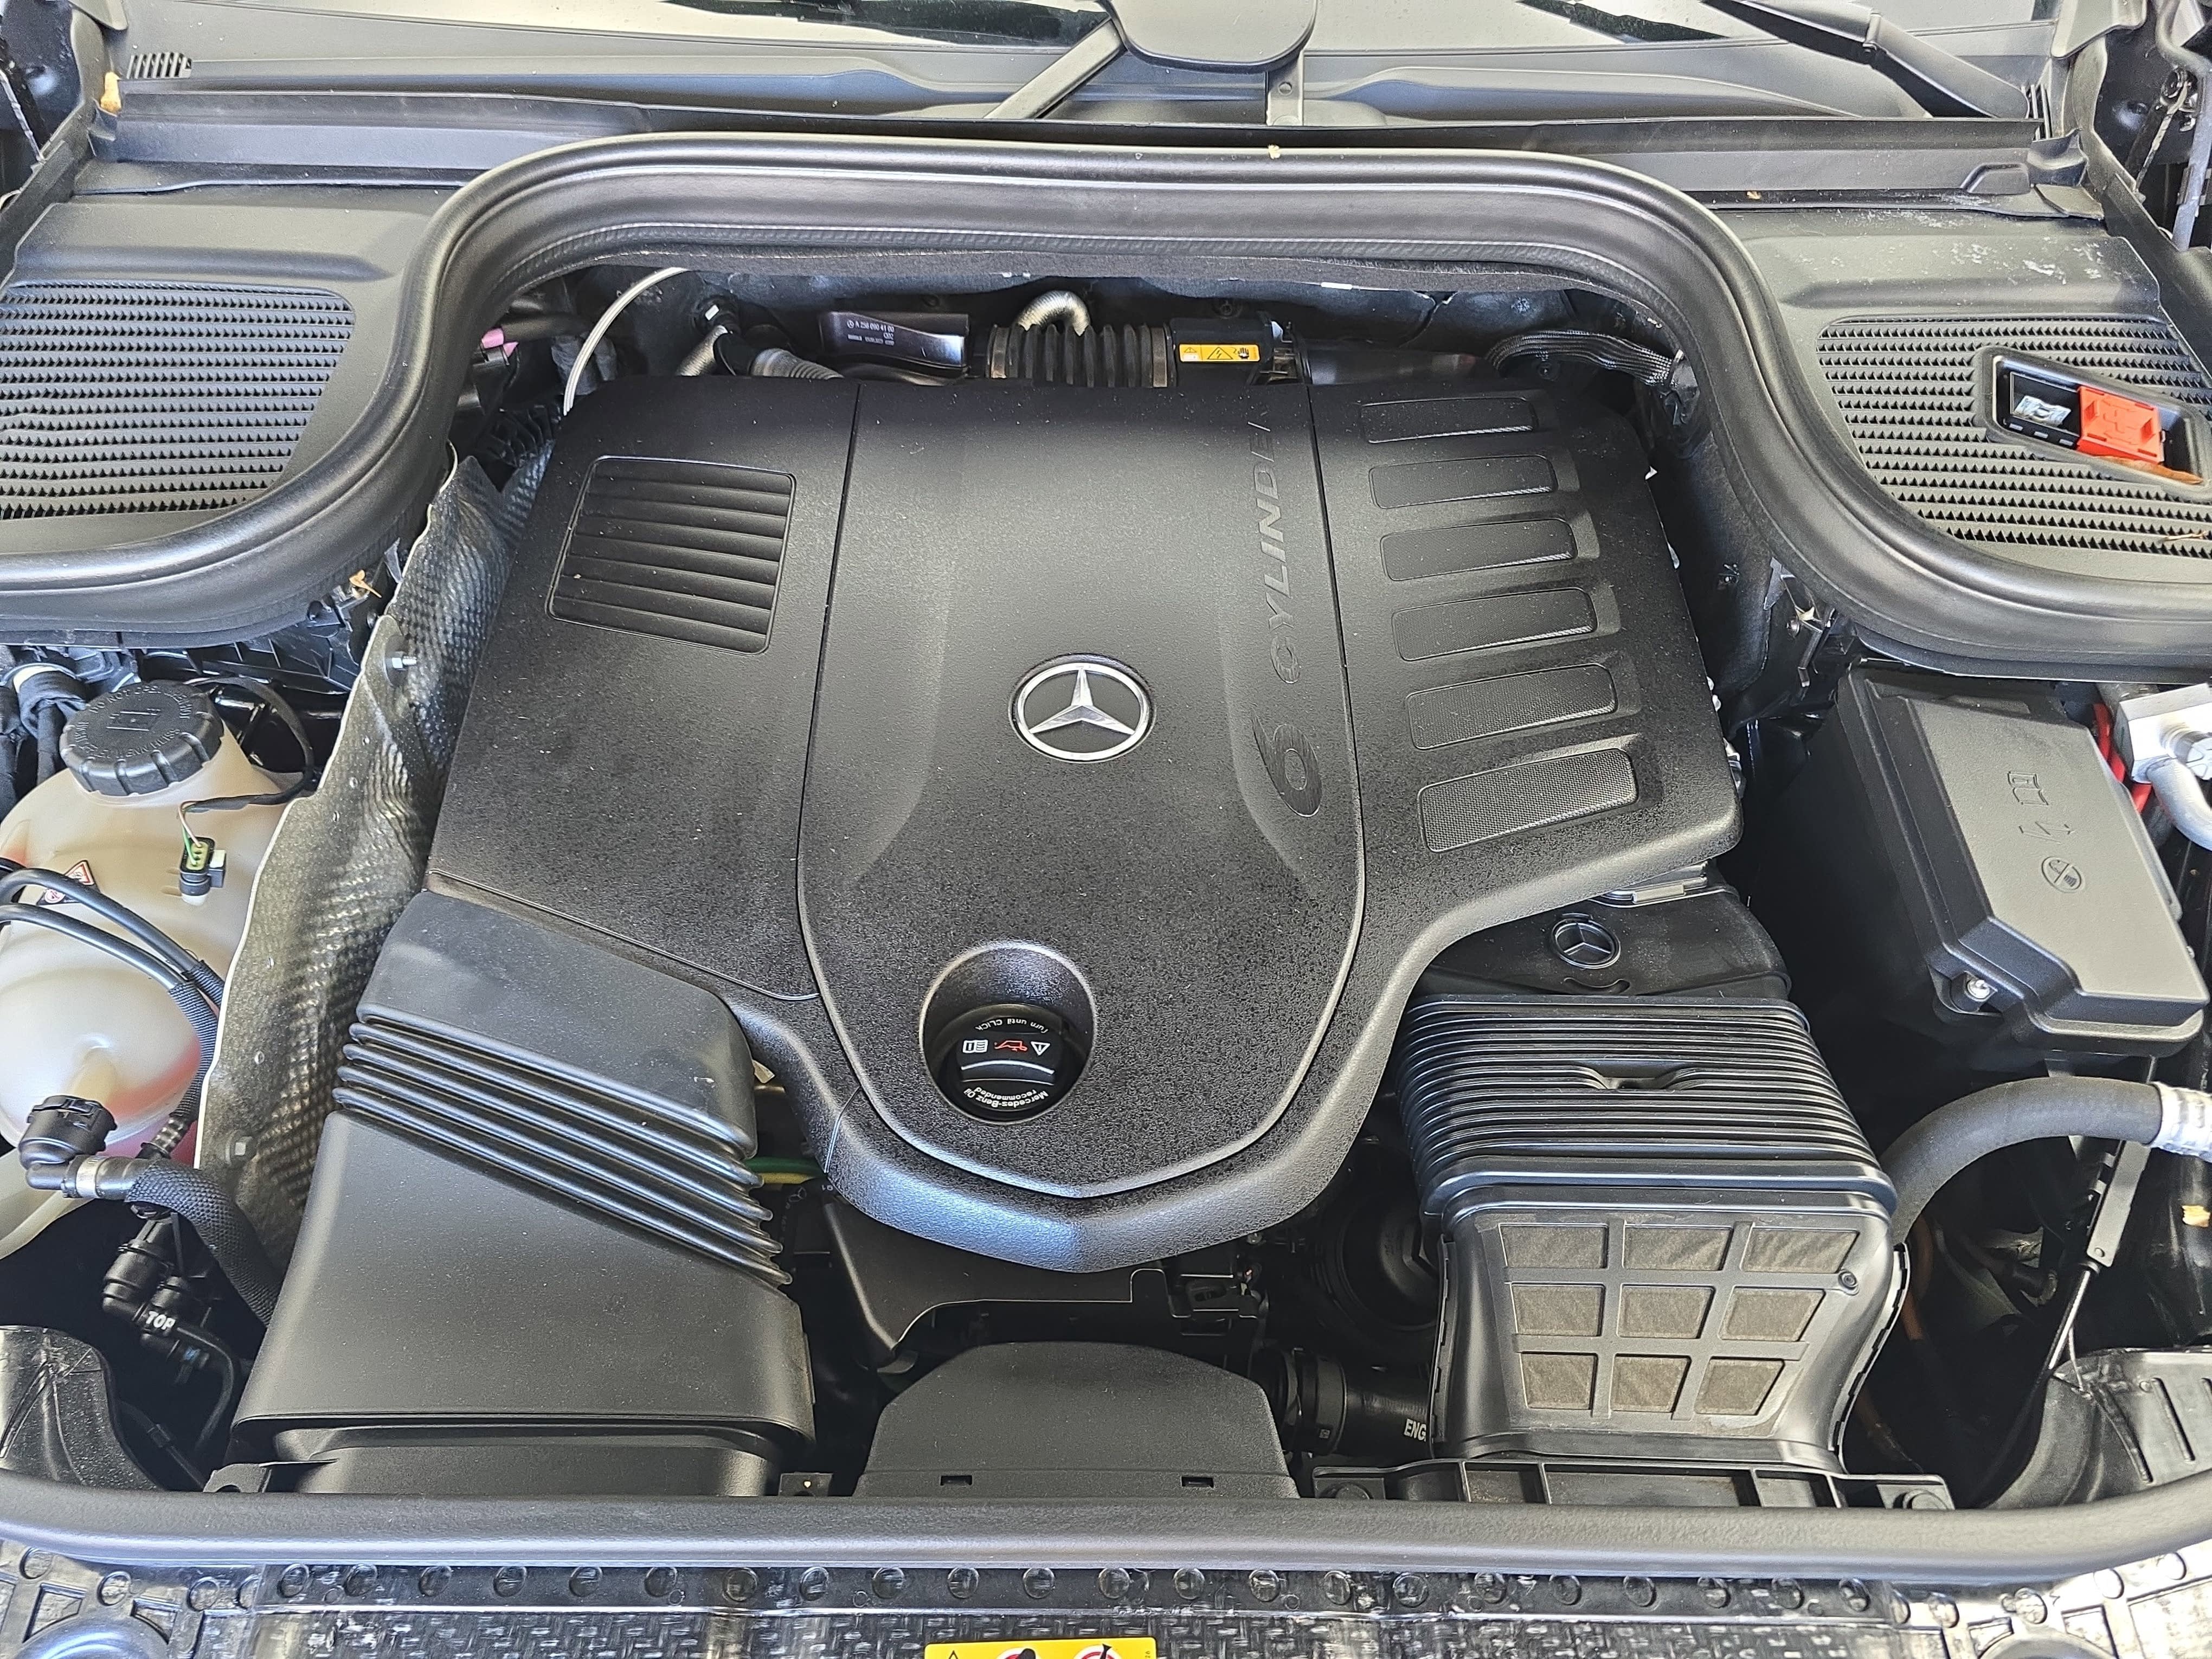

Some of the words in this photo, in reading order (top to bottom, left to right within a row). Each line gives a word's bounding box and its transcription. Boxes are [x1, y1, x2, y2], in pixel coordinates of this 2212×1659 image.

[88, 701, 106, 713] DO
[106, 689, 131, 703] NOT
[1252, 705, 1323, 818] 6
[975, 1019, 1003, 1032] CLICK
[1030, 1021, 1049, 1034] Turn
[963, 1088, 976, 1098] Oil
[974, 1086, 1037, 1101] recommended
[975, 1090, 1049, 1109] Mercedes-Benz
[145, 1310, 176, 1330] TOP
